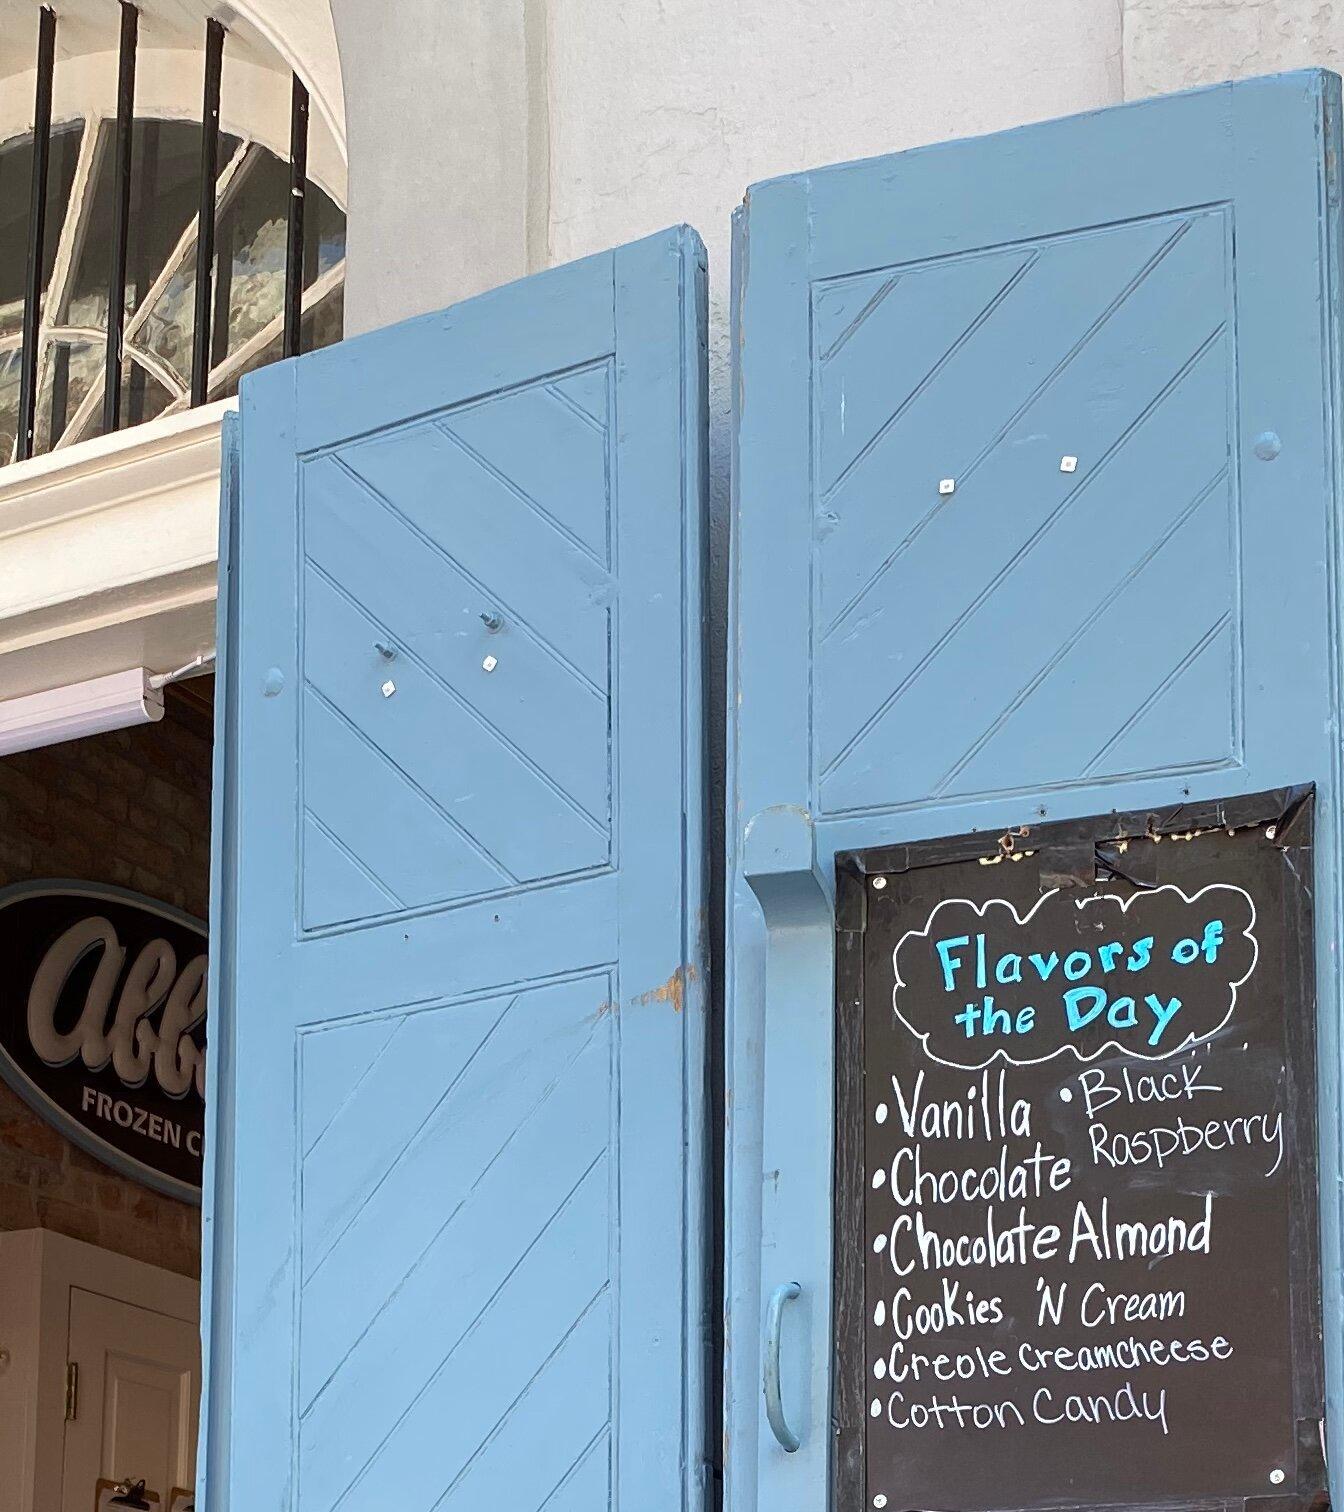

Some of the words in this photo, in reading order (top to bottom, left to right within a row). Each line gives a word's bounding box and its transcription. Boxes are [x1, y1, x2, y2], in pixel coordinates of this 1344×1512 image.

[935, 933, 1154, 991] Flavors
[1170, 919, 1224, 964] of
[955, 996, 1035, 1038] the
[1062, 986, 1182, 1046] Day
[81, 1086, 181, 1149] FROZEN
[891, 1068, 1032, 1141] Vanilla
[1077, 1064, 1223, 1119] Black
[891, 1142, 1071, 1207] Chocolate
[1088, 1111, 1284, 1177] Raspberry
[889, 1206, 1060, 1276] Chocolate
[1068, 1190, 1212, 1263] Almond
[891, 1278, 1004, 1340] Cookies
[1080, 1282, 1185, 1328] Cream
[888, 1342, 1012, 1383] Creole
[887, 1391, 1024, 1429] Cotton
[1032, 1381, 1169, 1435] Candy
